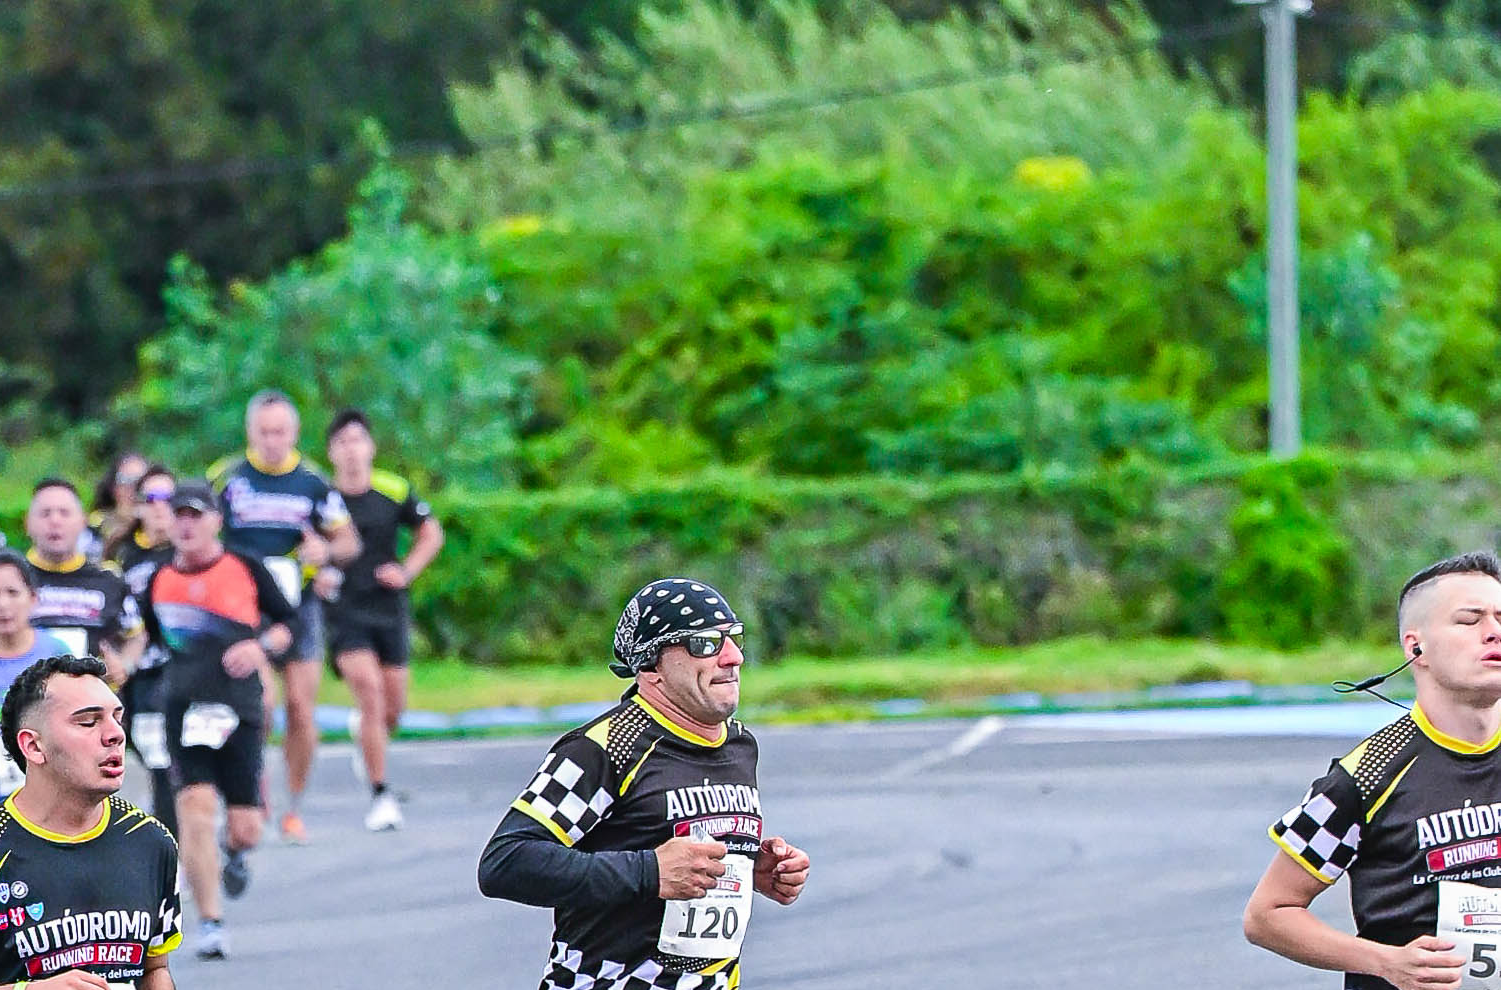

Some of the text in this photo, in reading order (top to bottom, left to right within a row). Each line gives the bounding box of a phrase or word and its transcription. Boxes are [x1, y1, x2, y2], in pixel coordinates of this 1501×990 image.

[1443, 839, 1498, 868] RUNNING
[1413, 874, 1426, 885] La
[14, 908, 151, 959] AUTÓDROMO
[677, 906, 739, 940] 120
[41, 945, 134, 972] RUNNING RACE
[1469, 943, 1501, 978] 5
[107, 968, 122, 979] del
